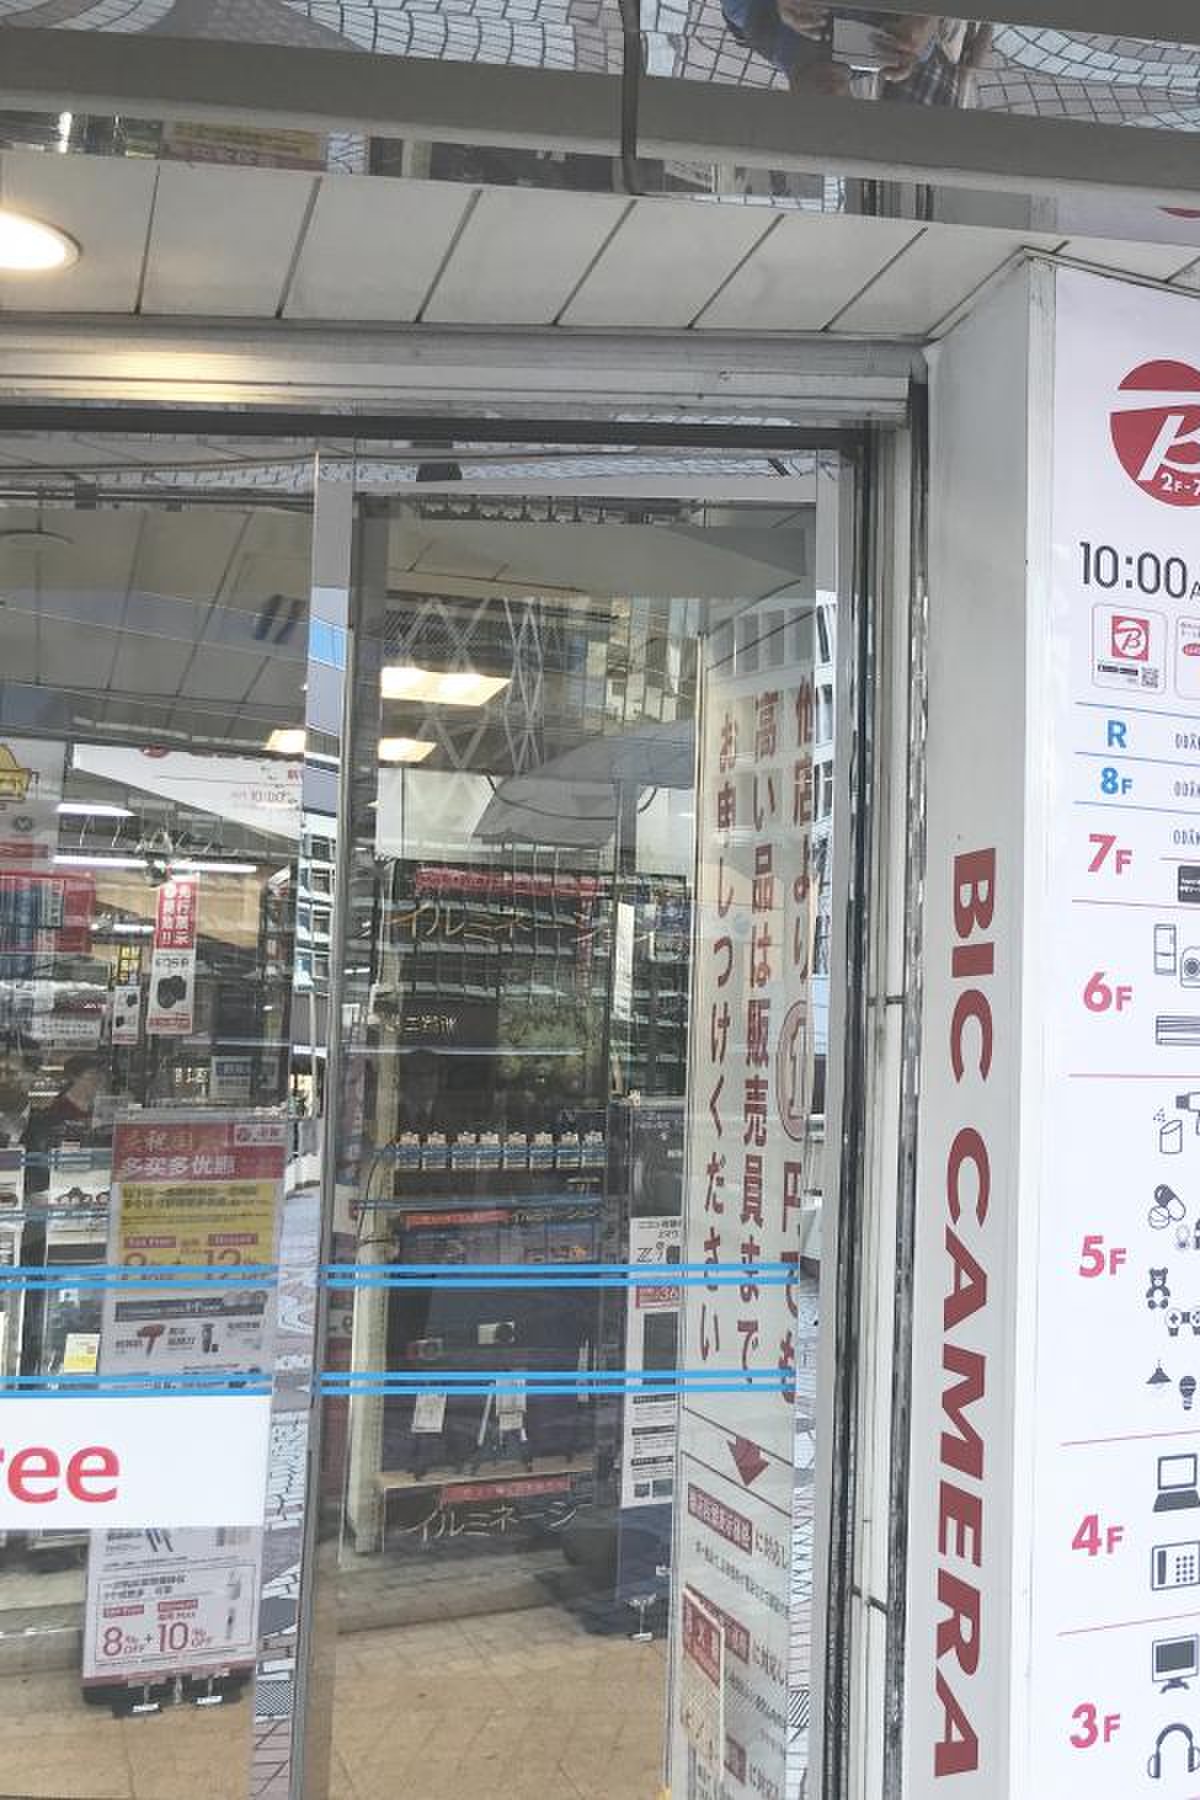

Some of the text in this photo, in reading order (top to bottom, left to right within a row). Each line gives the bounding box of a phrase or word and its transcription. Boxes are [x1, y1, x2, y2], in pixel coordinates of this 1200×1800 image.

[1107, 720, 1127, 748] R
[1100, 767, 1133, 795] 8F
[1087, 833, 1133, 874] 7F
[1083, 971, 1132, 1012] 6F
[1080, 1235, 1126, 1278] 5F
[934, 847, 997, 1778] BIC CAMERA
[0, 1446, 119, 1504] ee
[1071, 1514, 1124, 1556] 4F
[103, 1626, 123, 1656] 8
[158, 1622, 189, 1652] 10
[1070, 1702, 1121, 1749] 3F
